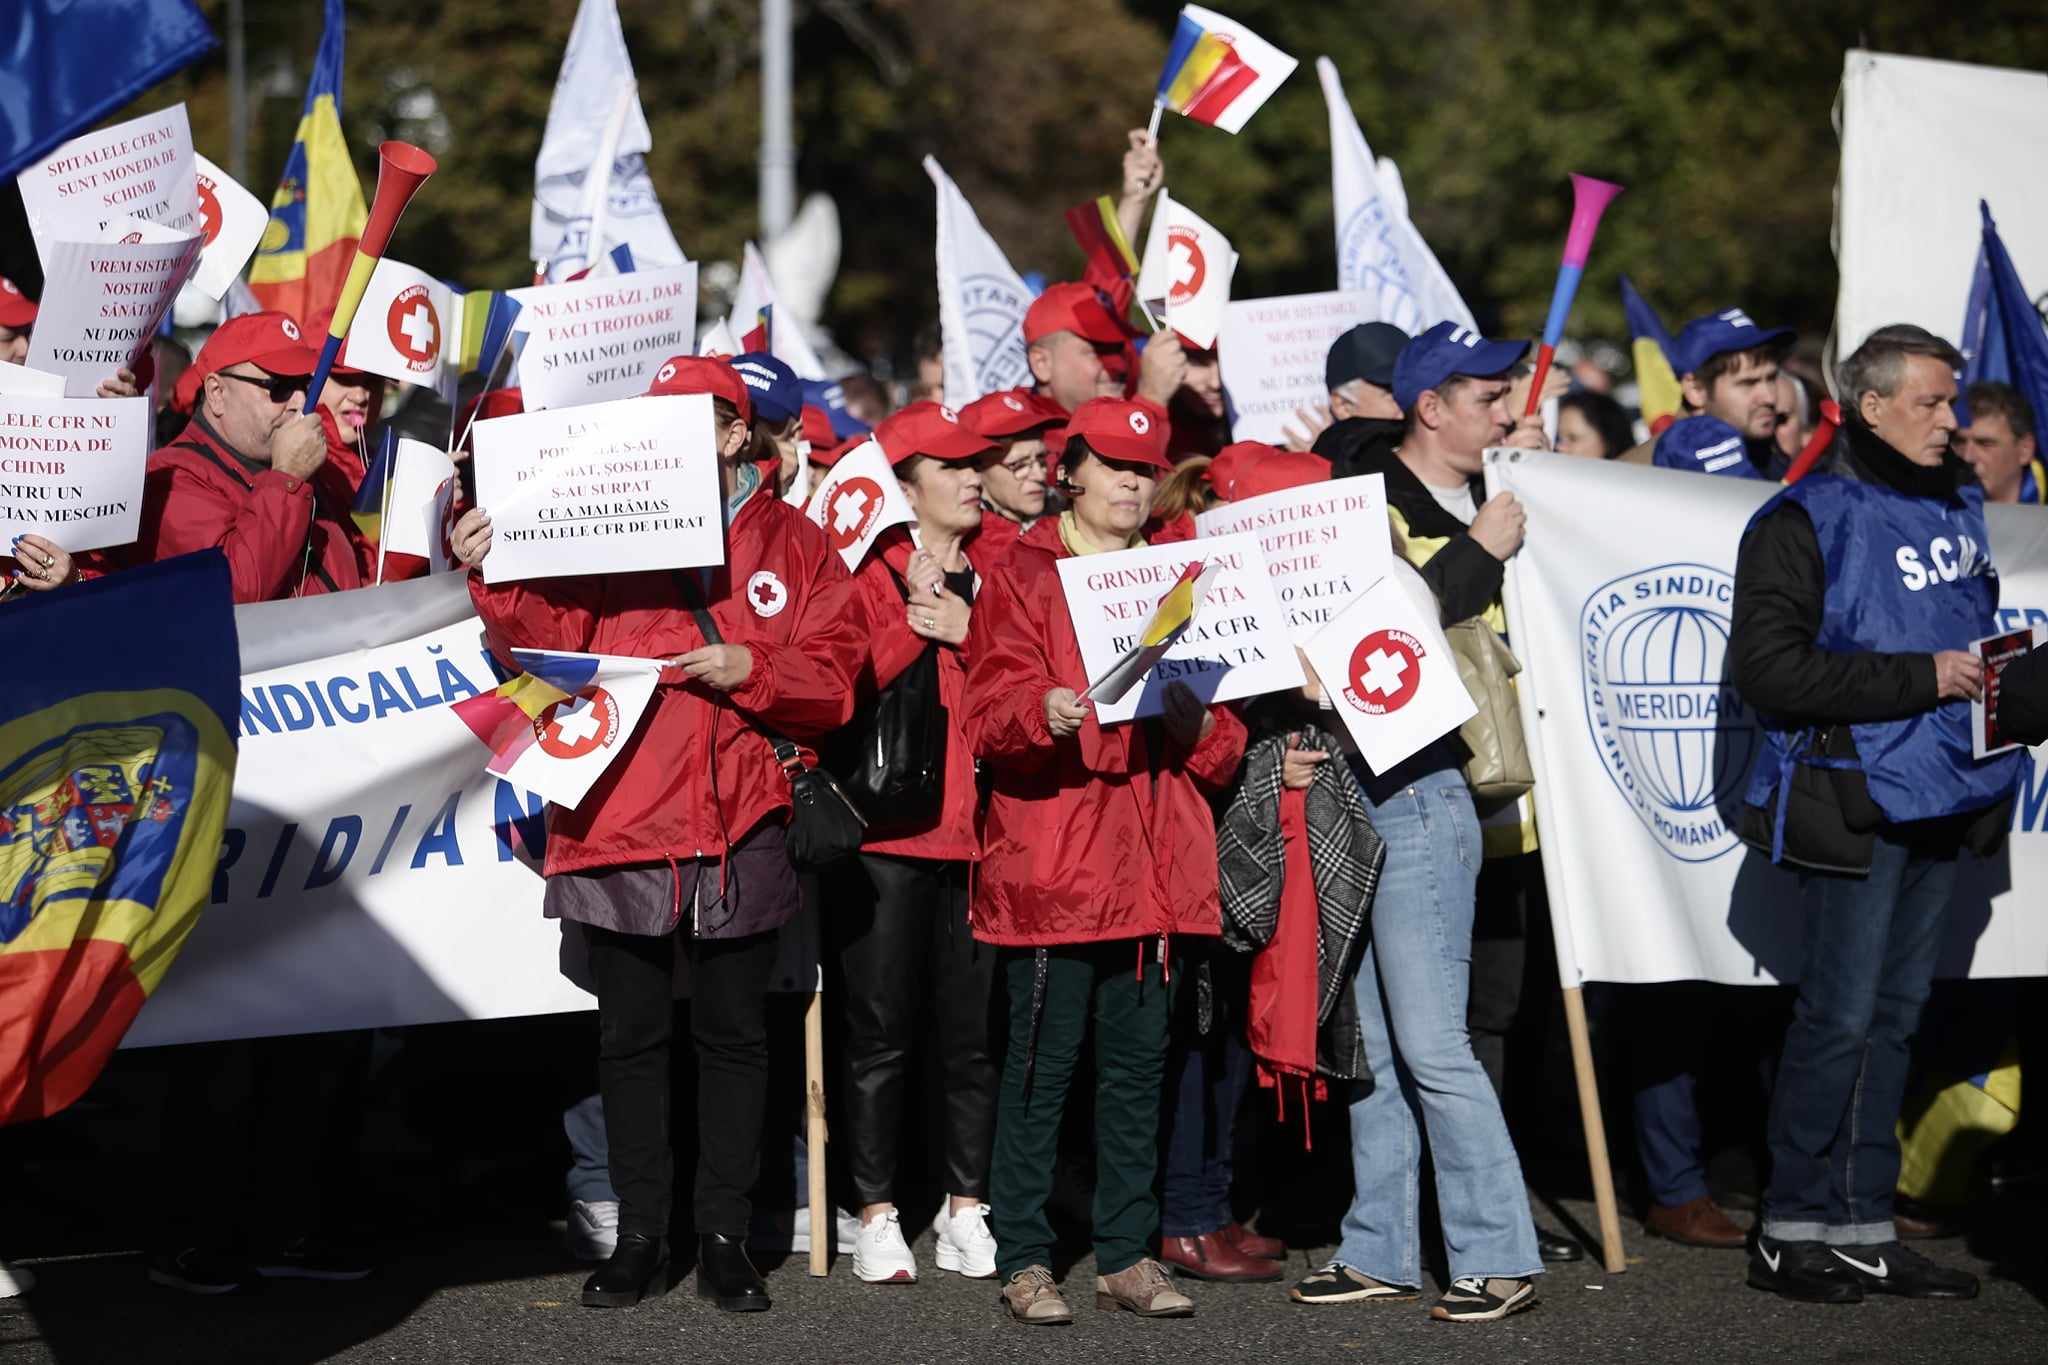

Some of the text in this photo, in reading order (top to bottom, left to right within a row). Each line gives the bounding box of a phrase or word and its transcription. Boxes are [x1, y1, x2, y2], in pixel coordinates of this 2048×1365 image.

[48, 126, 175, 177] SPITALELE CFR NU
[58, 149, 177, 198] SUNT MONEDA DE
[103, 180, 156, 208] SCHIMB
[89, 260, 133, 273] VREM
[103, 281, 158, 295] NOSTRU
[533, 303, 557, 319] NU
[564, 299, 581, 315] AI
[653, 283, 682, 300] DAR
[83, 328, 106, 341] NU
[548, 308, 673, 341] FACI TROTOARE
[53, 349, 124, 363] VOASTRE
[565, 350, 594, 366] MAI
[599, 341, 630, 358] NOU
[633, 330, 681, 351] OMORI
[586, 362, 645, 385] SPITALE
[48, 416, 86, 429] CFR
[92, 416, 117, 429] NU
[88, 438, 112, 451] DE
[623, 439, 658, 453] S-AU
[58, 487, 83, 500] UN
[552, 480, 652, 499] S-AU SURPAT
[44, 502, 128, 522] MESCHIN
[538, 499, 670, 521] CE A MAI RĂMAS
[1257, 498, 1339, 529] SĂTURAT
[1344, 495, 1370, 512] DE
[503, 516, 706, 542] SPITALELE CFR DE FURAT
[1281, 575, 1352, 603] O ALTĂ
[1635, 576, 1732, 602] SINDIC
[1103, 602, 1131, 622] NE
[1215, 615, 1260, 637] CFR
[1157, 656, 1211, 681] ESTE
[1216, 653, 1231, 668] A
[1233, 646, 1266, 664] TA
